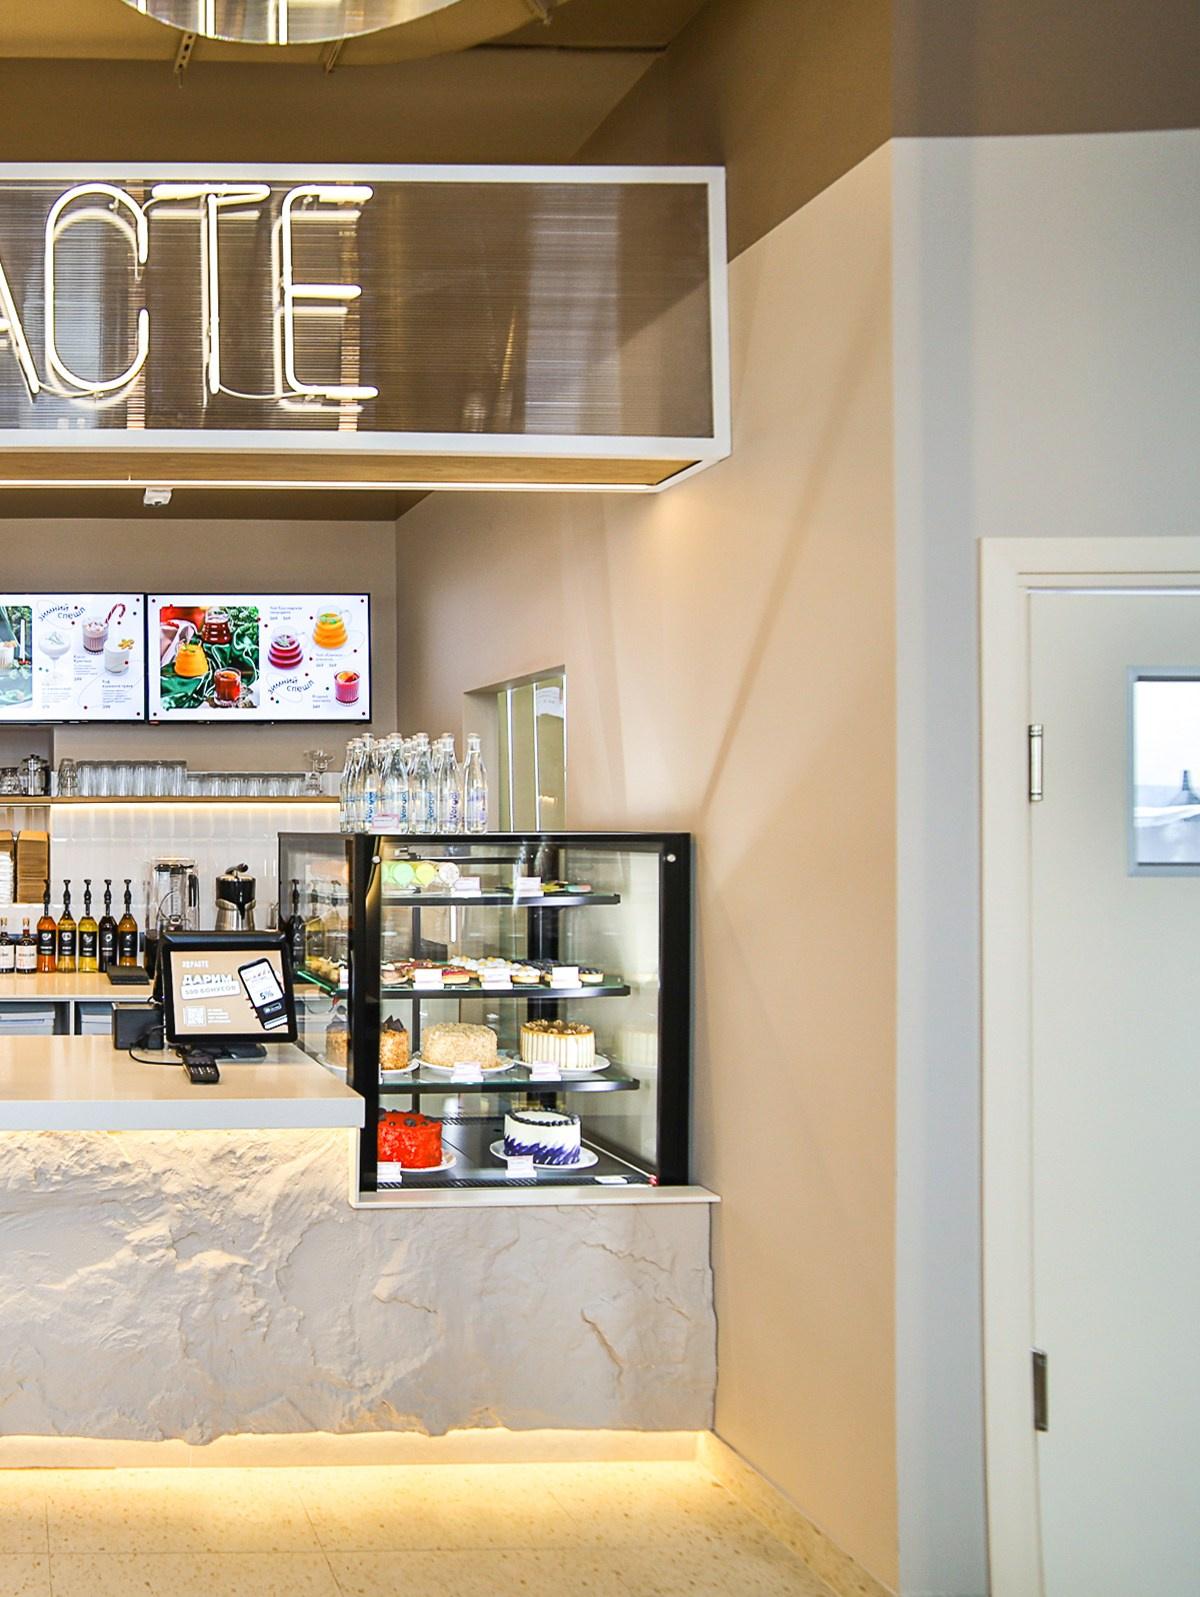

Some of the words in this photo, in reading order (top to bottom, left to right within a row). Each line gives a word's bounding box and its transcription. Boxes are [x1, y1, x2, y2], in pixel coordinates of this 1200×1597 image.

[38, 604, 69, 622] зимний
[57, 606, 86, 619] спешл
[268, 676, 299, 695] зимний
[287, 679, 315, 693] спешл
[182, 974, 233, 985] ДАРИМ
[259, 989, 274, 1001] 5%
